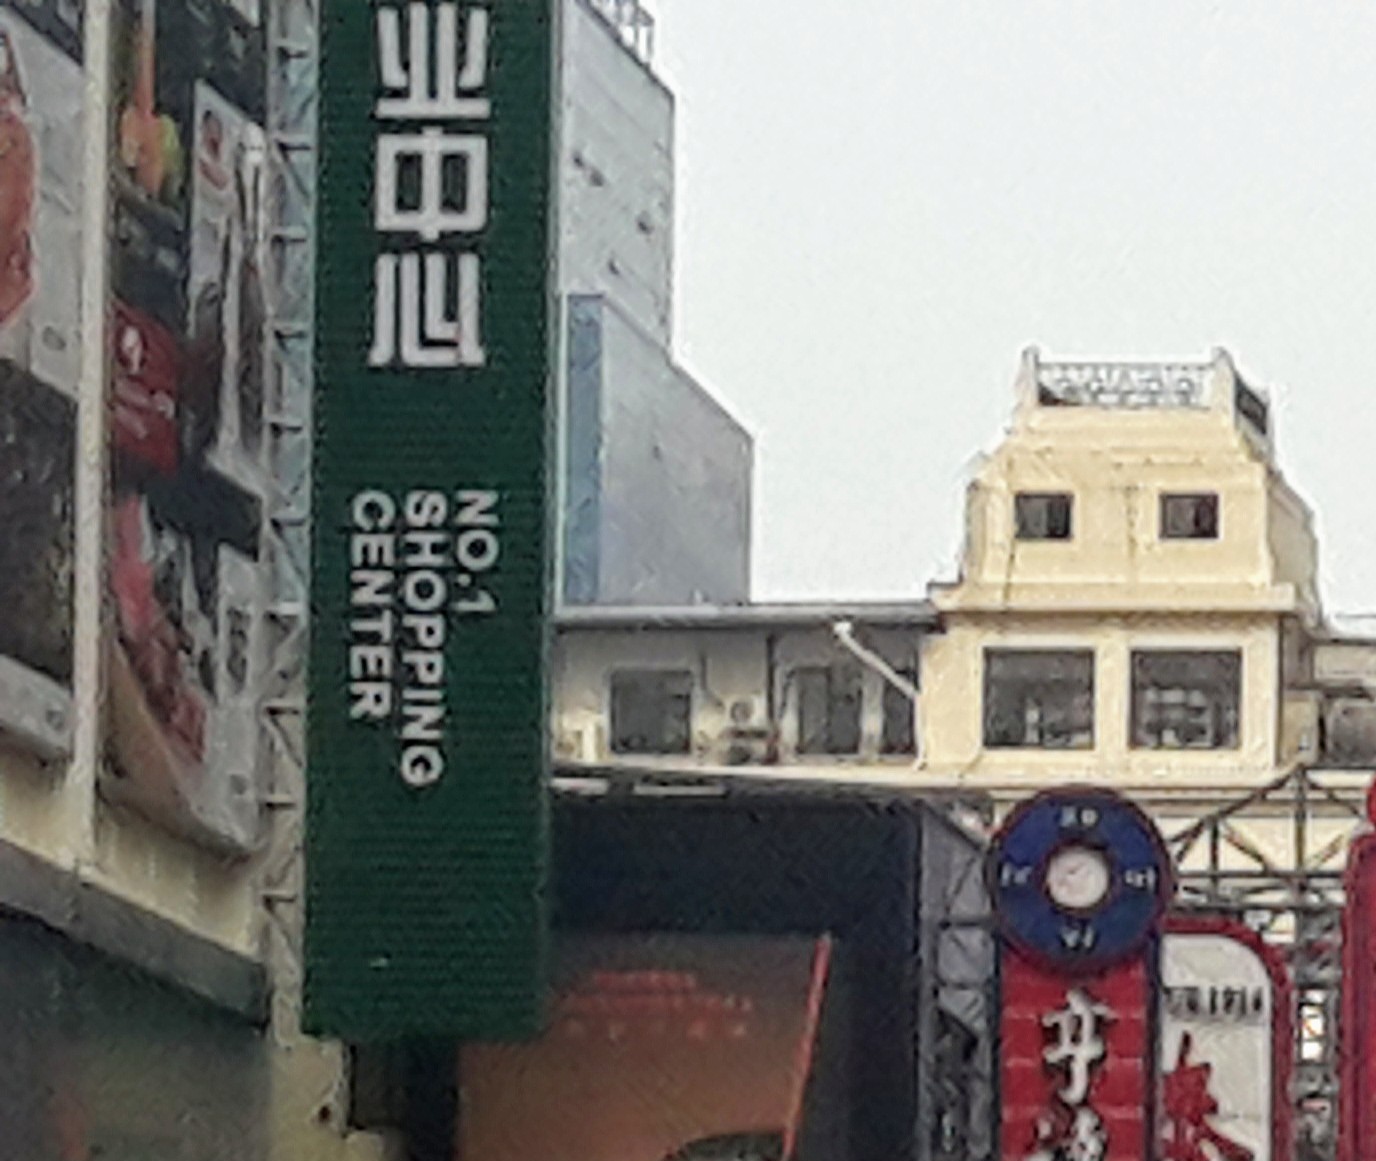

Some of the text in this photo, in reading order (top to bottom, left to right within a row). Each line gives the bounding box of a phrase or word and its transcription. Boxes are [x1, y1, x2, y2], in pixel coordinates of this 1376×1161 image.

[369, 2, 491, 367] 业中心
[349, 489, 397, 720] CENTER
[401, 488, 448, 788] SHOPPING
[454, 488, 500, 613] NO.1
